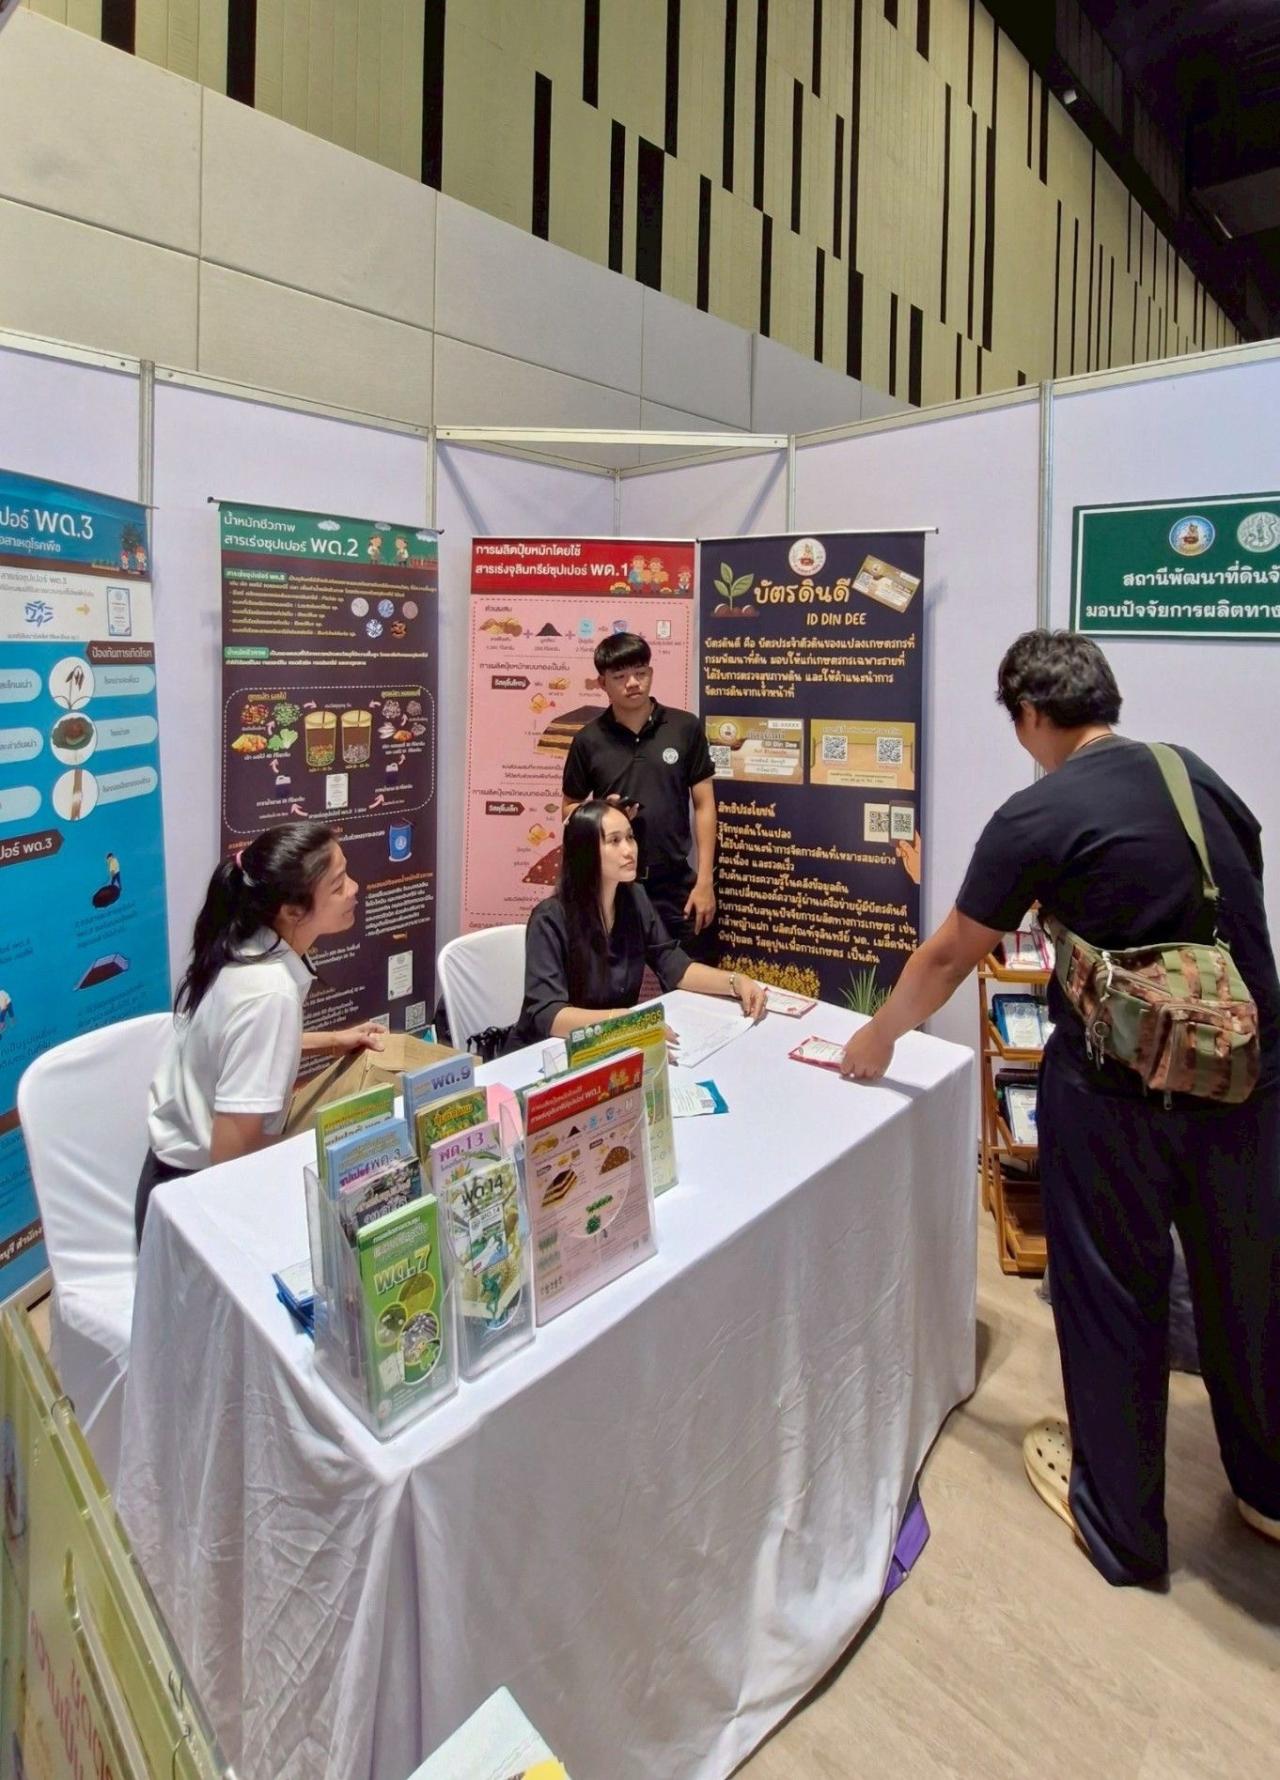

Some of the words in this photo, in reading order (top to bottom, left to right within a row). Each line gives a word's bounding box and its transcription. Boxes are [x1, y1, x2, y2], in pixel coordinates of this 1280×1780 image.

[35, 509, 93, 540] พด.3
[224, 511, 296, 533] น้ำหมักชีวภาพ
[224, 533, 307, 554] สารเร่งซุปเปอร์
[310, 537, 359, 557] พด.2
[476, 543, 581, 558] การผลิตปุ๋ยหมักโดยใช้
[475, 562, 588, 578] สารเร่งจุลินทรีย์ซุปเปอร์
[590, 563, 628, 577] พด.1
[754, 578, 851, 603] บัตรดินดี
[806, 612, 818, 625] ID
[821, 613, 842, 625] DIN
[845, 612, 867, 625] DEE
[1086, 599, 1280, 618] มอบปัจจัยการผลิตทาง
[23, 837, 53, 853] พด.3
[374, 1244, 432, 1296] พด.7
